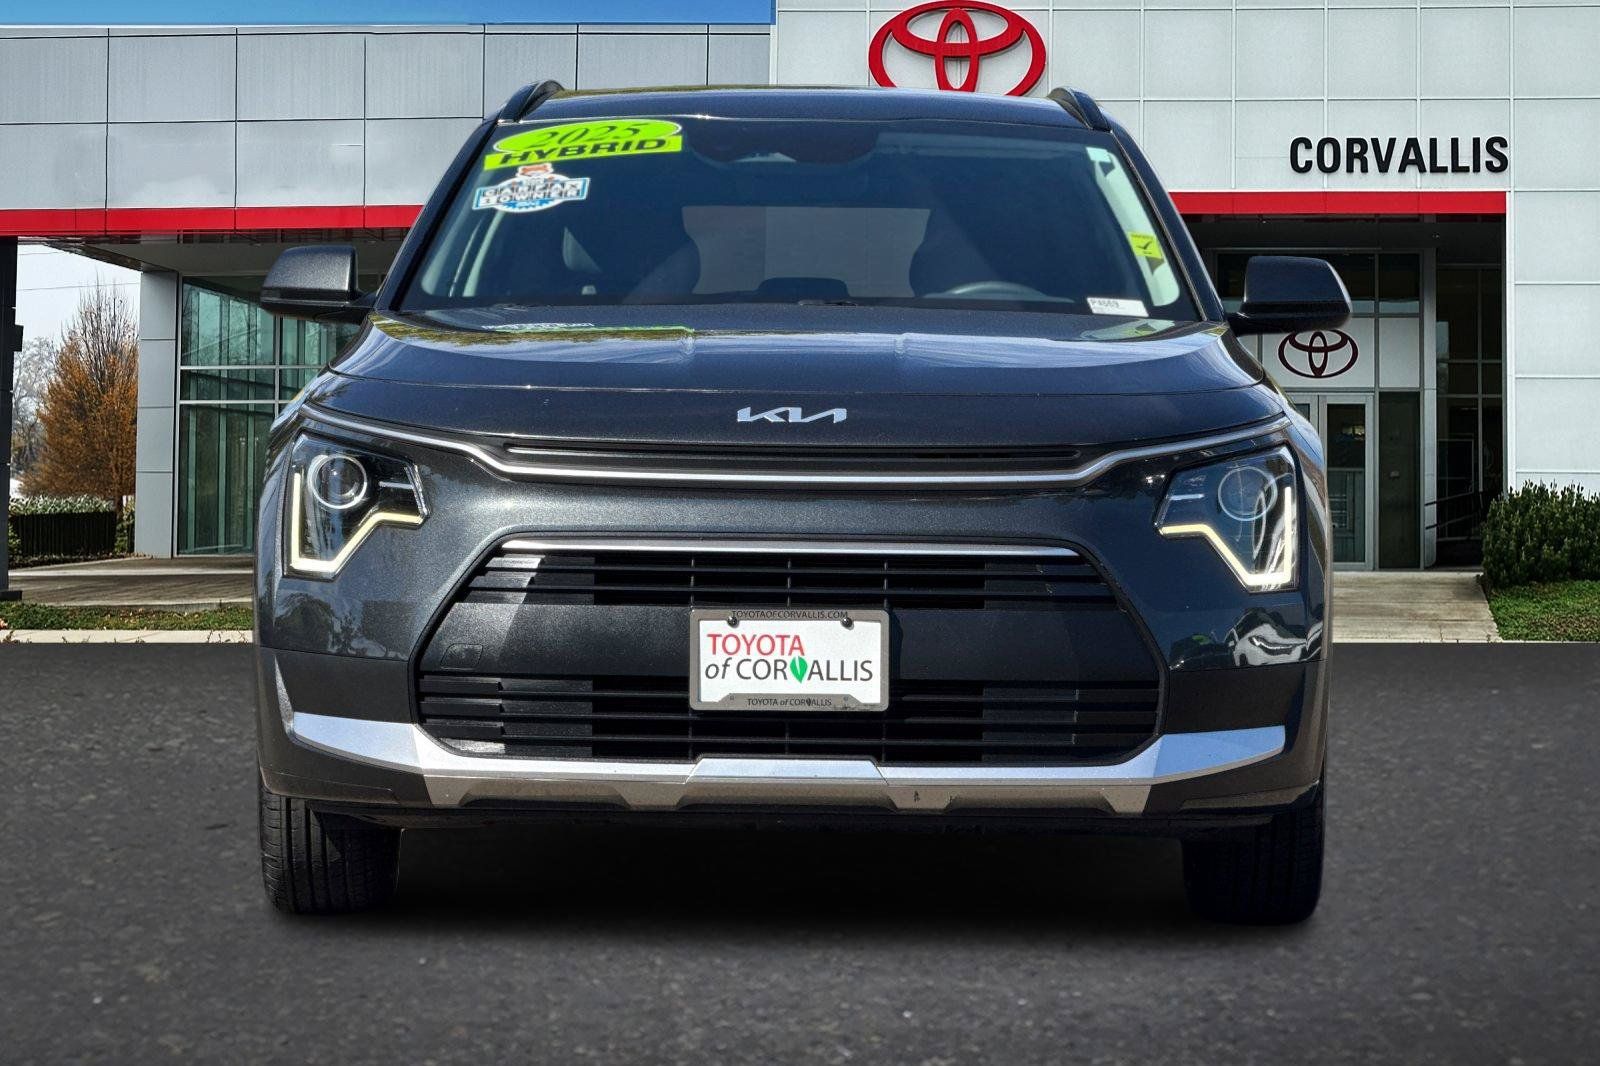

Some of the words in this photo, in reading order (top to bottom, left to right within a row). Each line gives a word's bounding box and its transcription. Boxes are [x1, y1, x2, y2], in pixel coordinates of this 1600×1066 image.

[526, 122, 649, 148] 2025
[500, 138, 666, 164] HYBRID
[1289, 136, 1509, 174] CORVALLIS
[731, 610, 848, 619] TOYOTAOFCORVALLIS.COM
[707, 633, 805, 656] TOYOTA
[705, 657, 732, 680] of
[747, 698, 778, 706] TOYOTA
[780, 698, 788, 706] of
